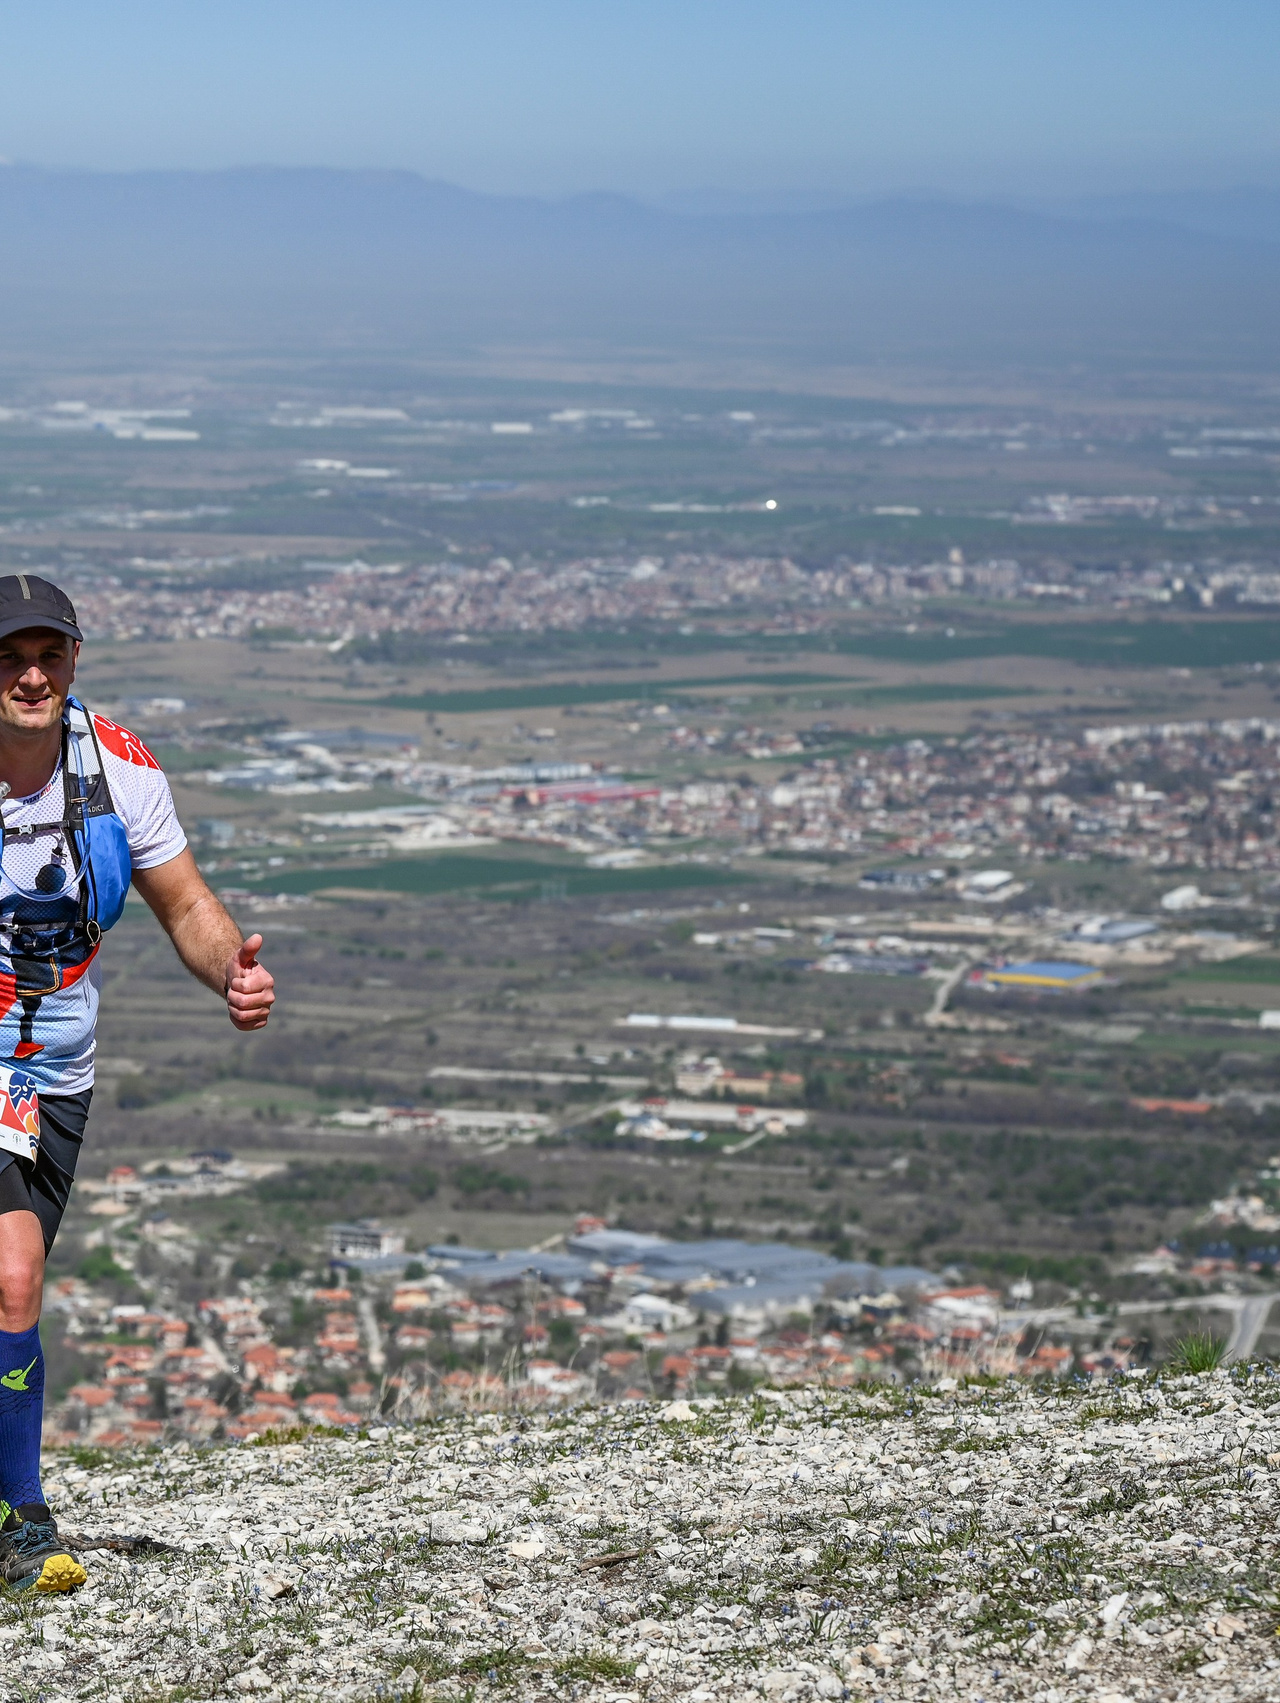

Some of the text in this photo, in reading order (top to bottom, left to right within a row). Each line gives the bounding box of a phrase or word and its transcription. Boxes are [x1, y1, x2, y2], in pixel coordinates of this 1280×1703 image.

[23, 795, 40, 805] EVERY
[40, 784, 52, 796] STEP
[77, 804, 105, 814] EADICT
